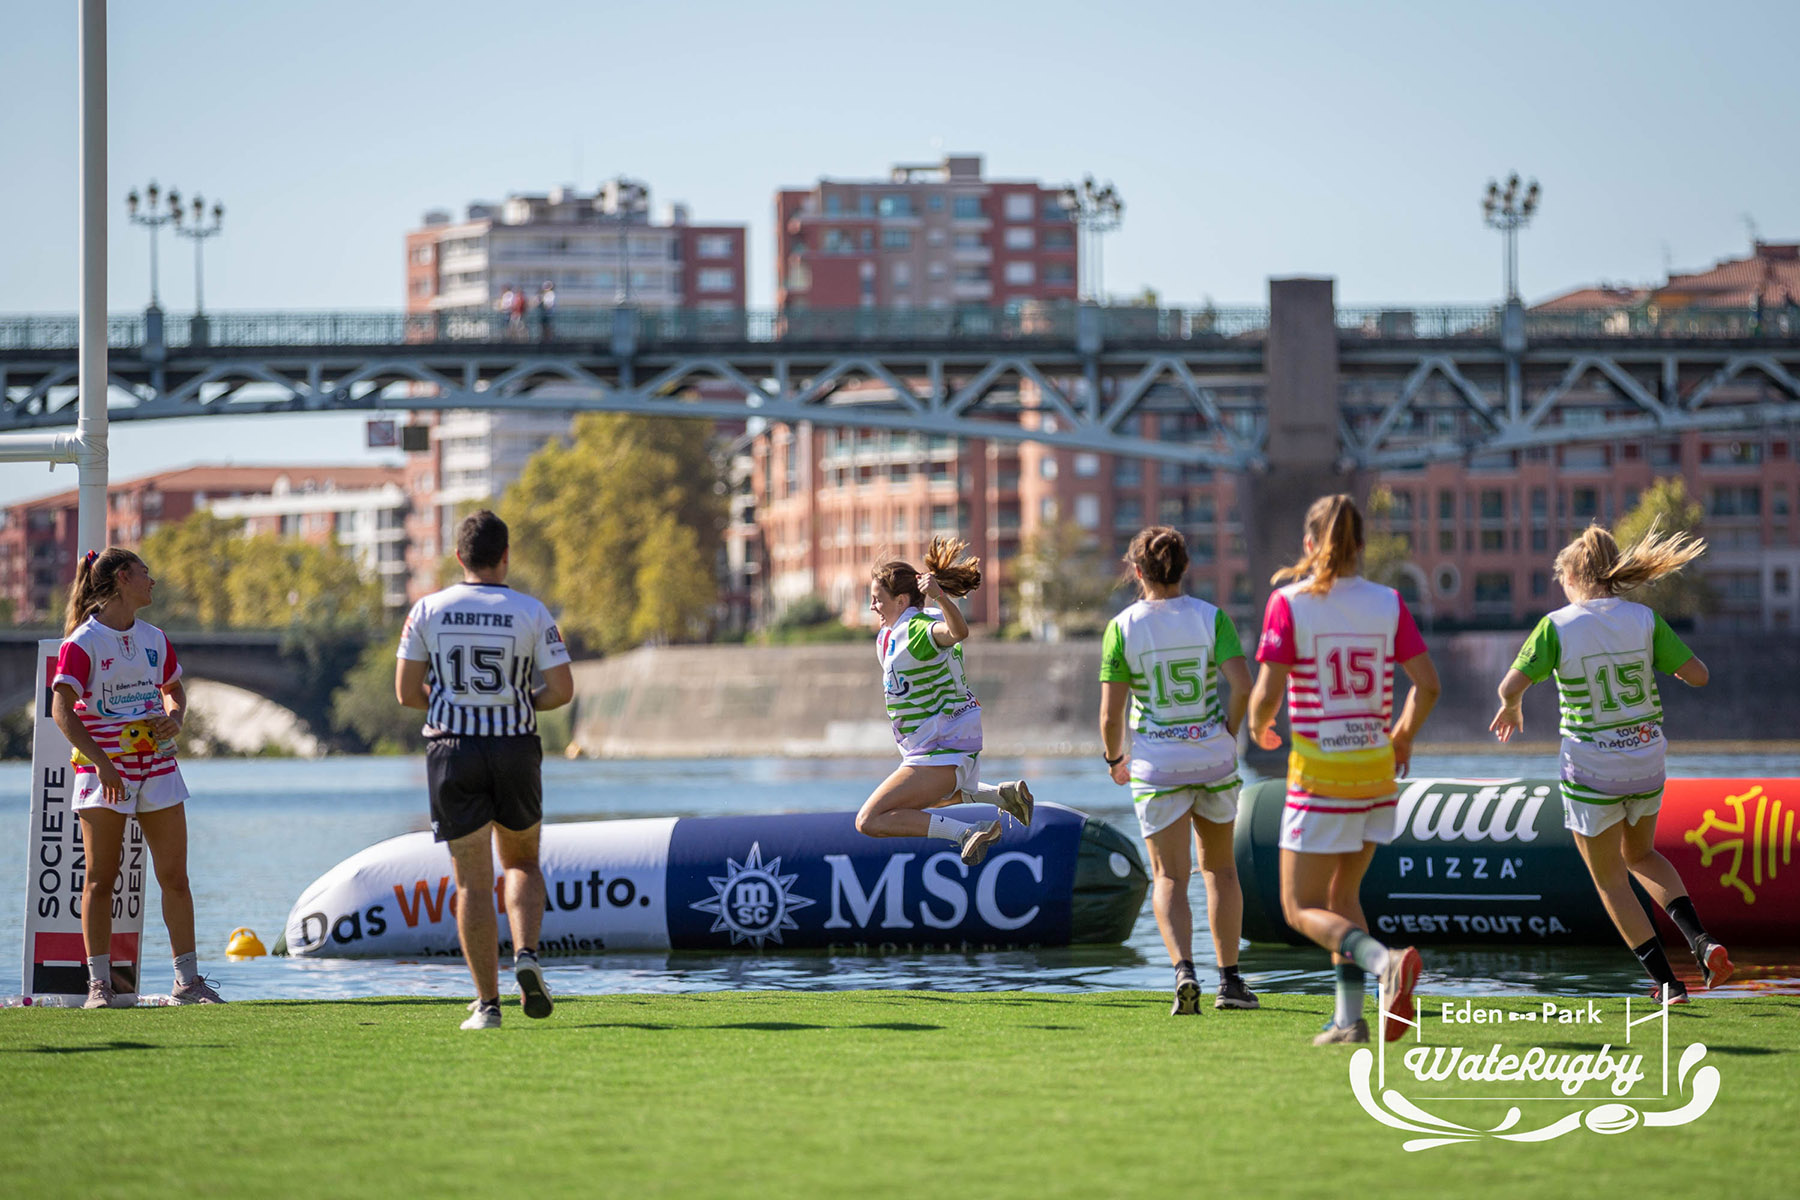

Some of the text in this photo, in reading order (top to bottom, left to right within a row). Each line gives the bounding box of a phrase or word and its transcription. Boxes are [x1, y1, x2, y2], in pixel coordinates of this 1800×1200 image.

[441, 612, 513, 628] ARBITRE
[448, 645, 506, 695] 15
[1152, 658, 1204, 709] 15
[1326, 646, 1379, 701] 15
[1595, 660, 1650, 713] 15
[1391, 778, 1551, 842] Tutti
[38, 767, 65, 919] SOCIETE
[128, 817, 143, 919] GENE
[823, 850, 1043, 930] MSC
[300, 904, 388, 953] Das
[1376, 914, 1450, 934] C'EST
[1453, 915, 1523, 934] TOUT
